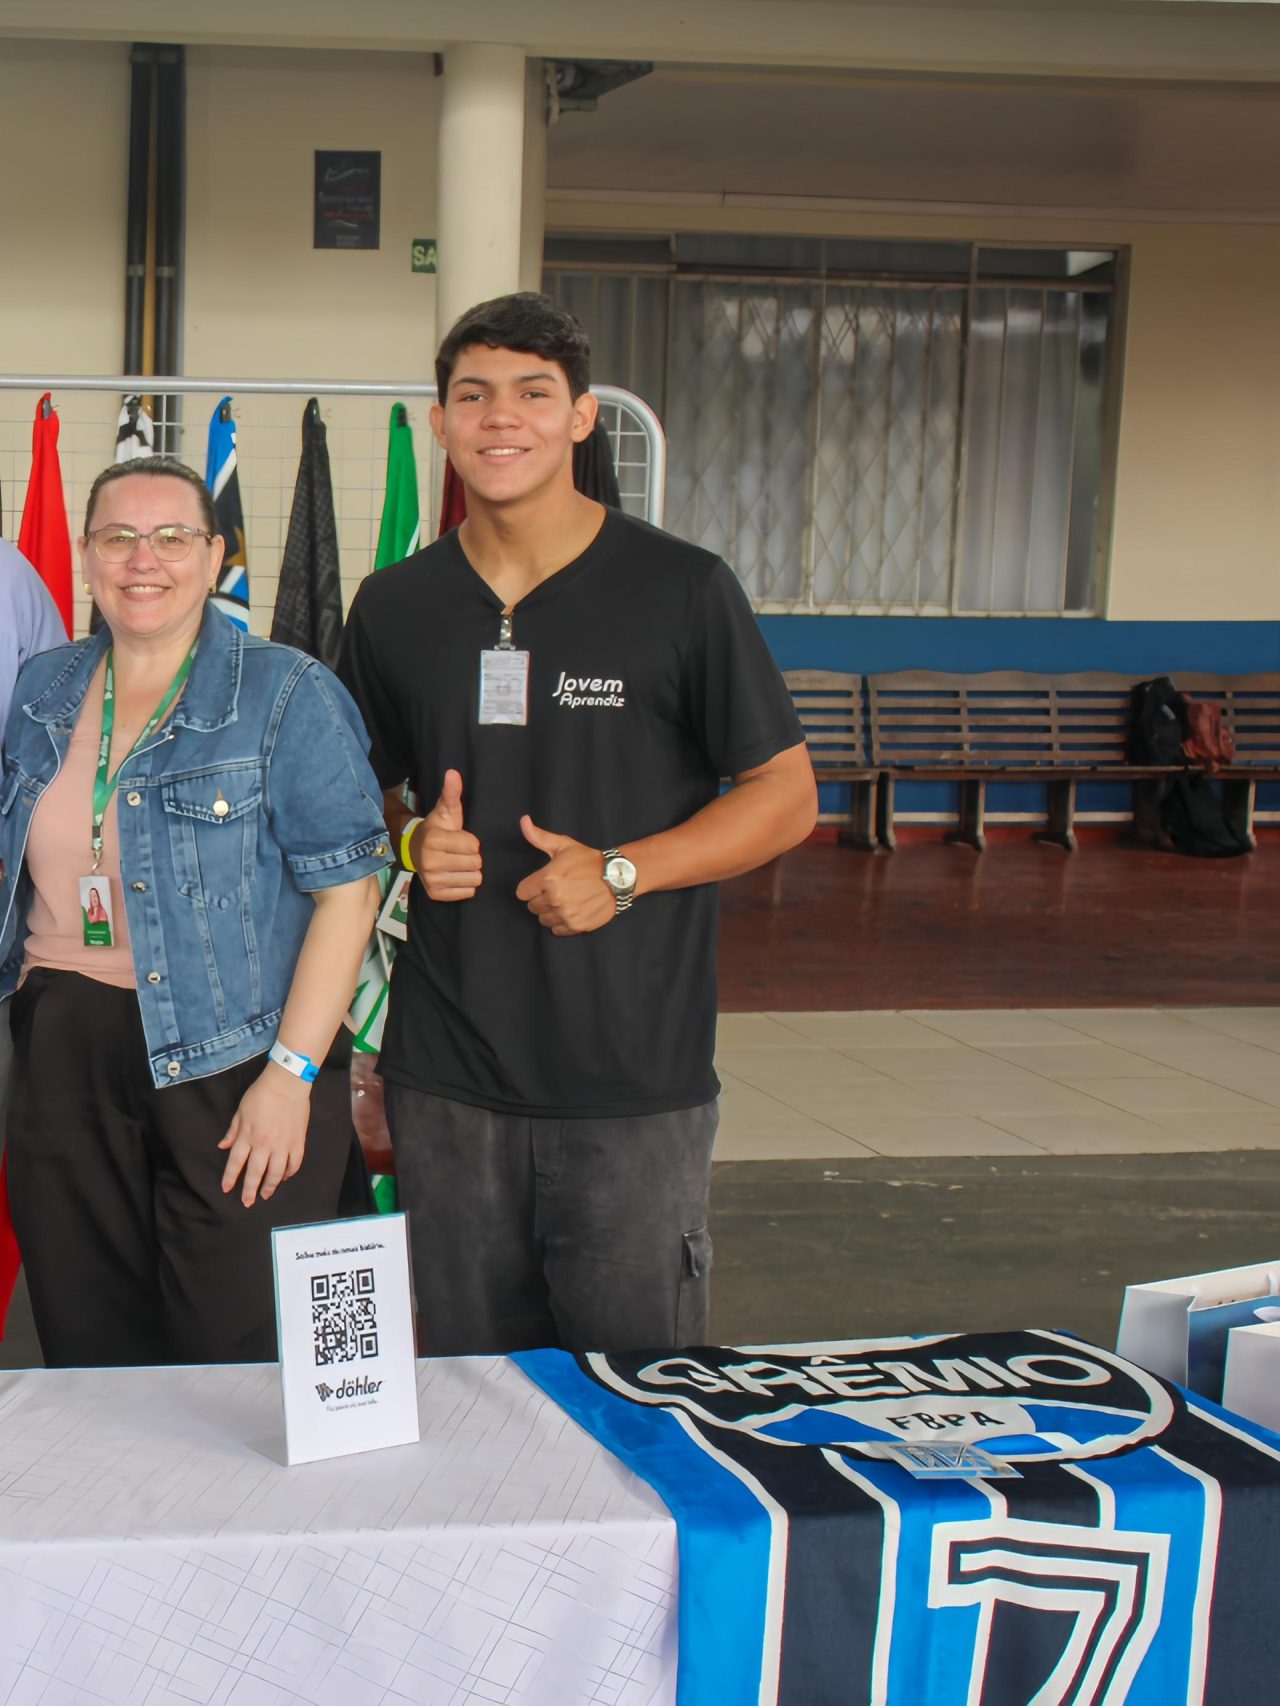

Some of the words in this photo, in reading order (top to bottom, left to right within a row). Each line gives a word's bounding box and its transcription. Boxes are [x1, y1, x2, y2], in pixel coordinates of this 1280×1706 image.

[552, 671, 623, 697] Jovem
[559, 692, 625, 709] Aprendiz
[335, 1375, 382, 1399] döhler
[637, 1354, 1112, 1397] GRÊMIO
[886, 1411, 1005, 1430] FBPA
